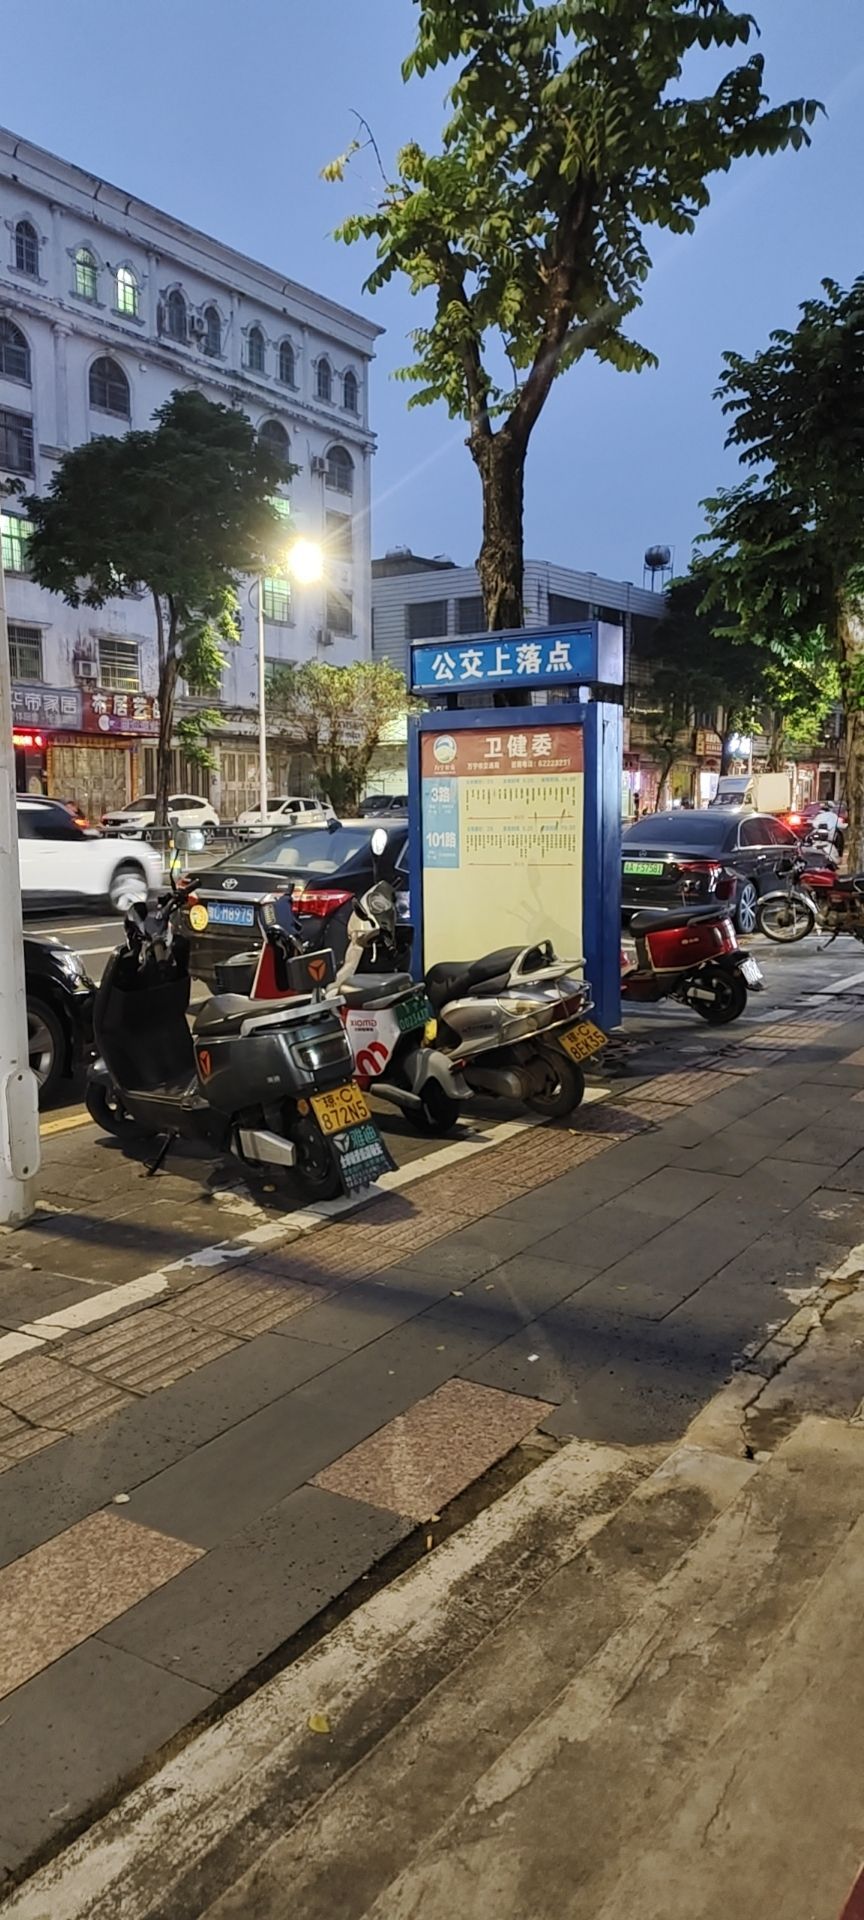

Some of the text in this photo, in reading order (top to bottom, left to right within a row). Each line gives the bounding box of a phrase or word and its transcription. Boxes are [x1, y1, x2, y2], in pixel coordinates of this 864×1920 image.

[431, 640, 573, 681] 公交上落点
[484, 733, 552, 758] 卫健委
[431, 786, 450, 803] 3路
[426, 831, 456, 848] 101路
[570, 1031, 606, 1060] 8EK35
[321, 1100, 368, 1130] 872N5
[349, 1124, 380, 1149] 雅迪
